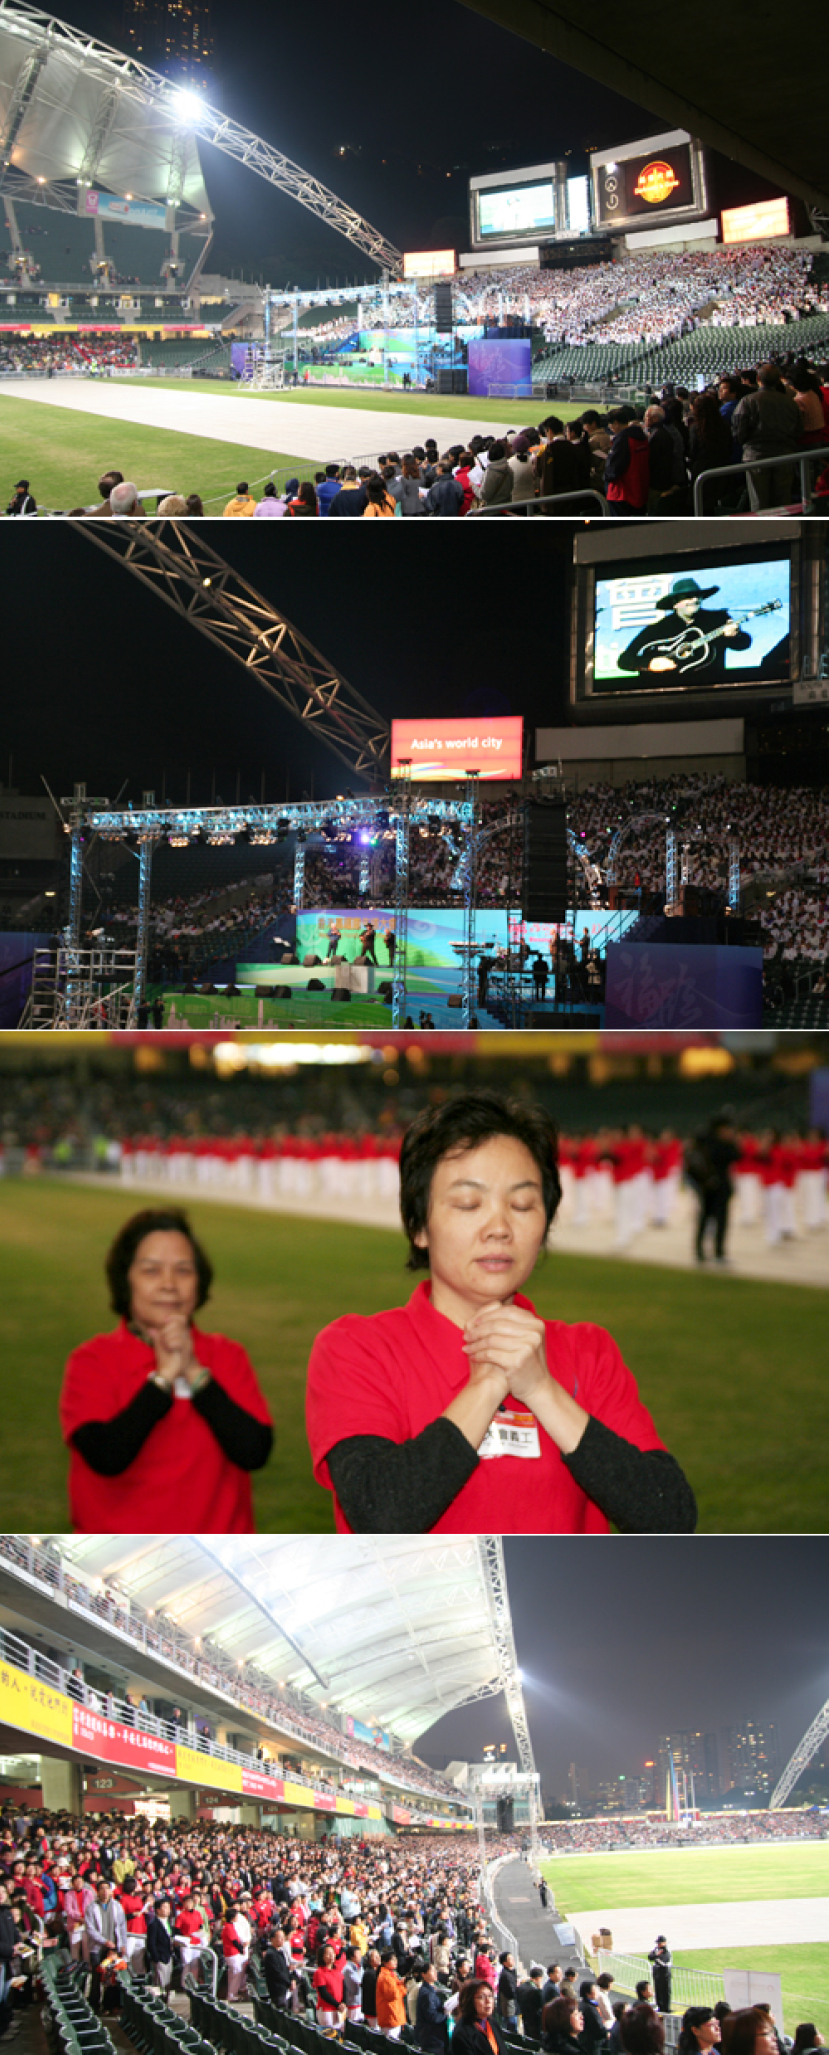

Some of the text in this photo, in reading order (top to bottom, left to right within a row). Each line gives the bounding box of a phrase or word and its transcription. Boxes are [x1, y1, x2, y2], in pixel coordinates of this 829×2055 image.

[410, 736, 503, 750] Asia's world city
[95, 1777, 113, 1789] 123
